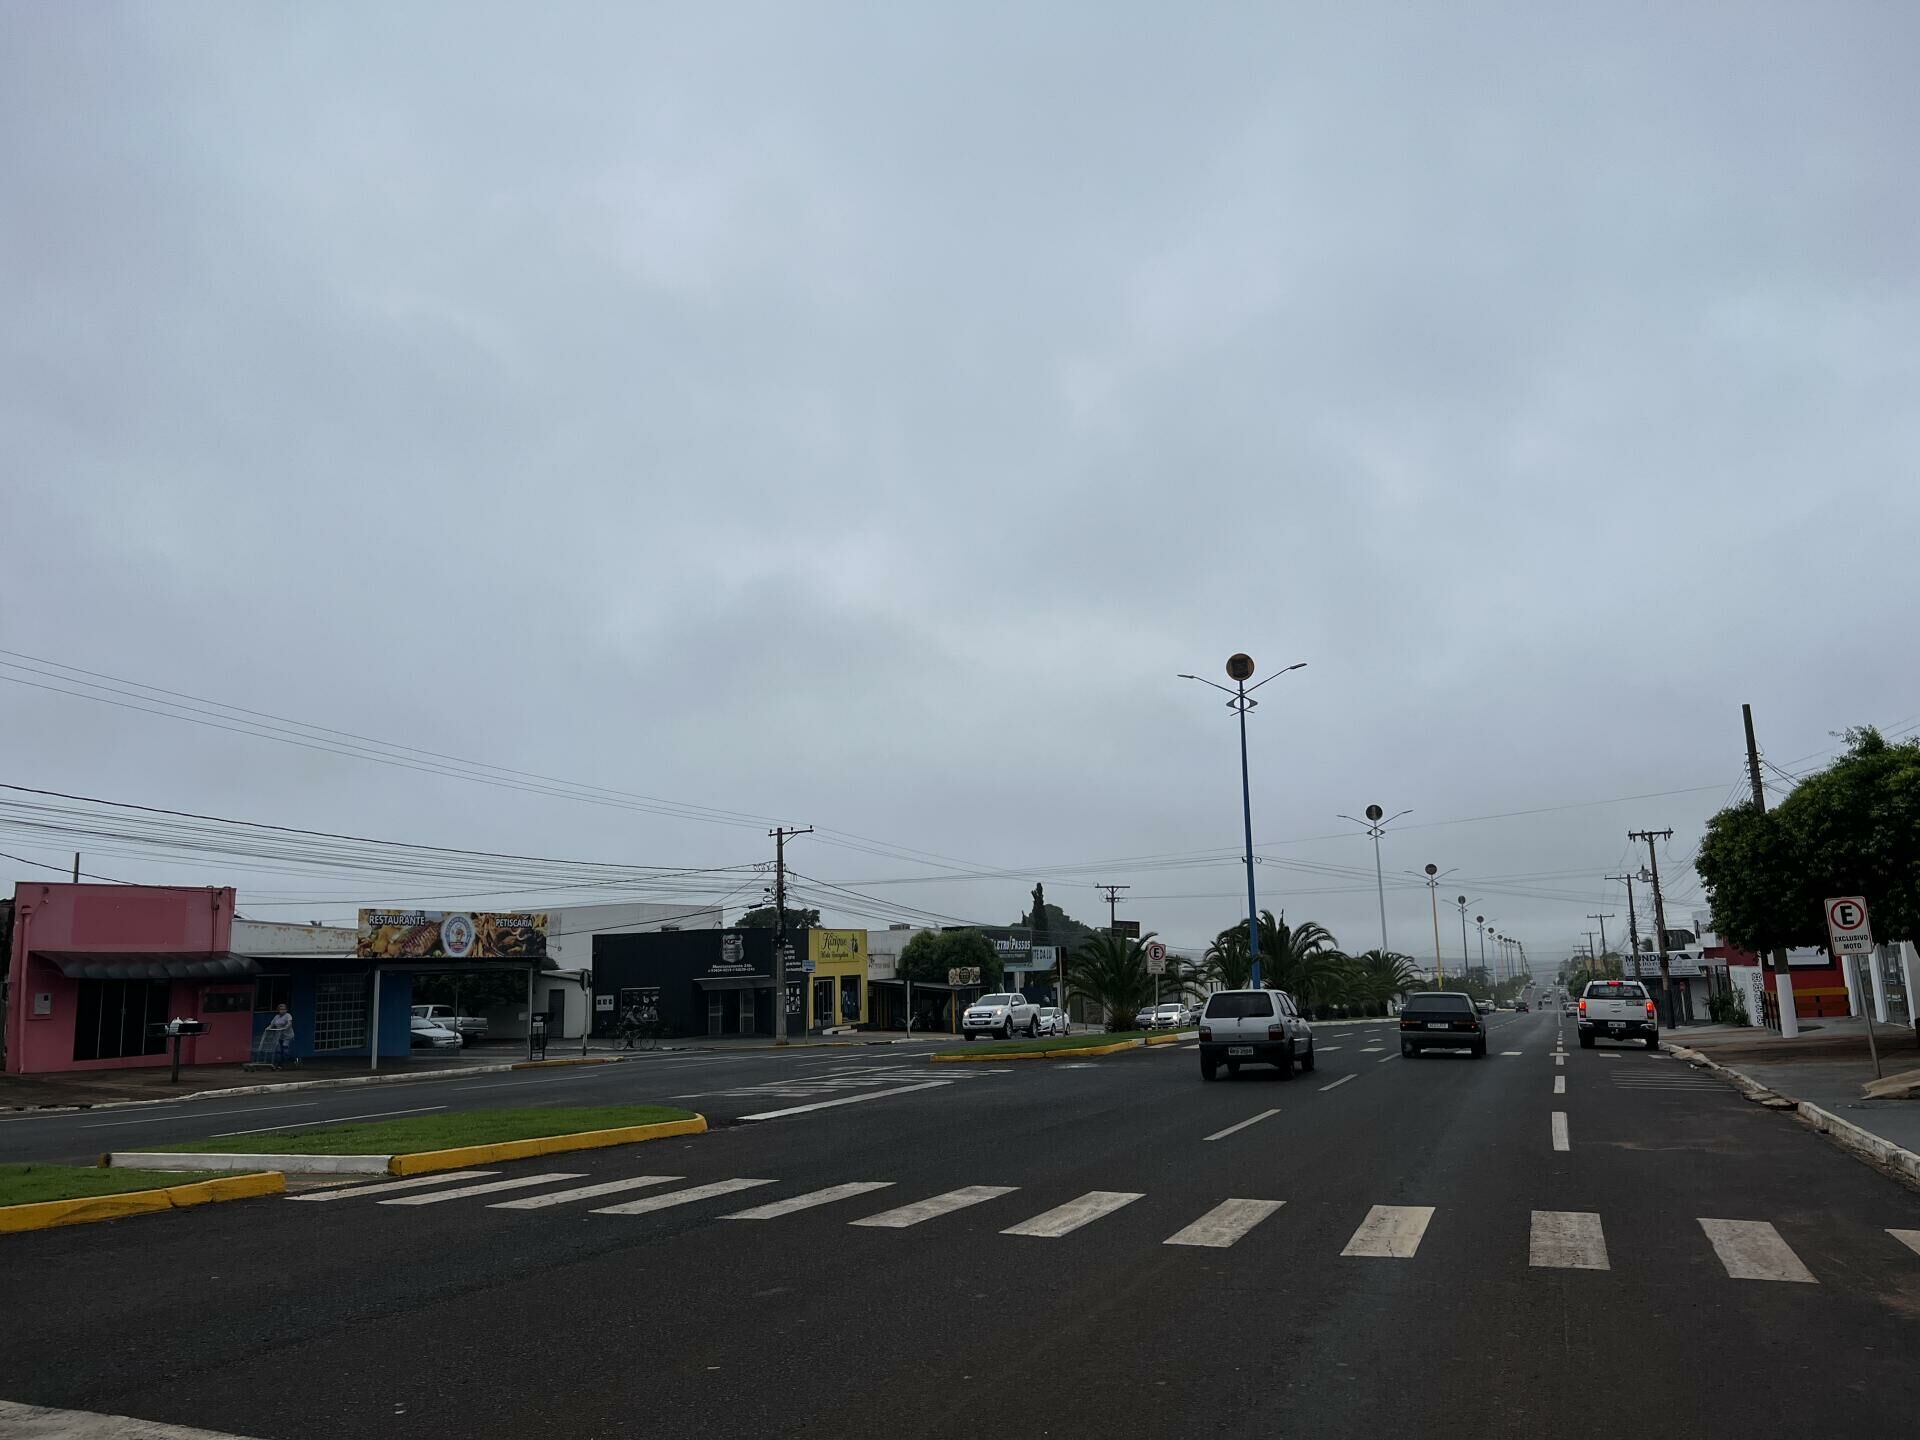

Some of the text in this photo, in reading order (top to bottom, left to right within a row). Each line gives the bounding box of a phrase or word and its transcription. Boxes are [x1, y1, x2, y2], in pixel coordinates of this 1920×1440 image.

[369, 915, 425, 926] RESTAURANTE
[1840, 905, 1854, 925] E
[495, 918, 532, 927] PETISCARIA
[992, 938, 1031, 950] LETRO PASSOS
[1154, 948, 1159, 958] E
